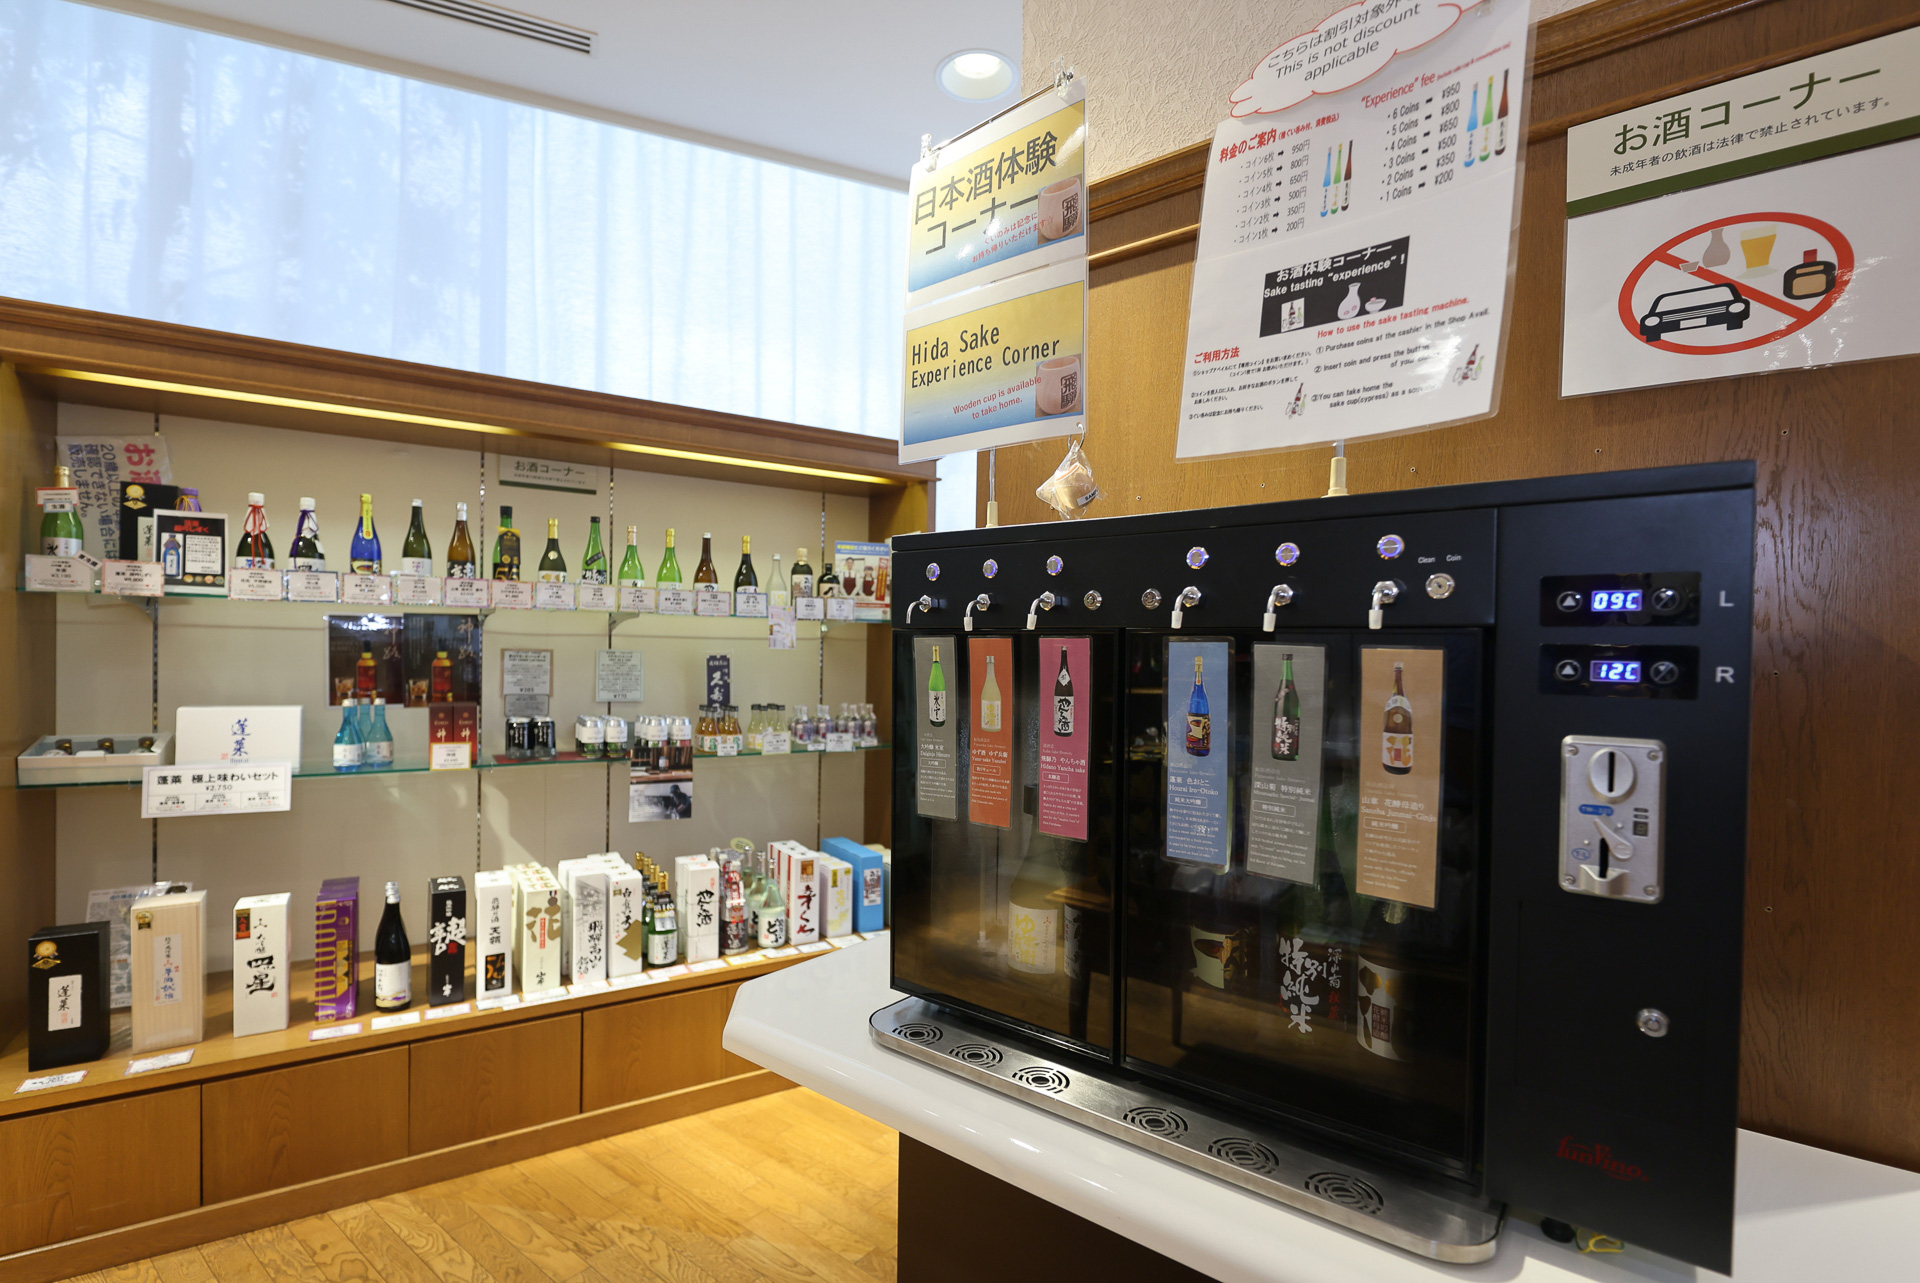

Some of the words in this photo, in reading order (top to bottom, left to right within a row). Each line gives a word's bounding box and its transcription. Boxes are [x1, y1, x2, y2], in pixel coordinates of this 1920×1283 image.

[1276, 59, 1303, 79] This
[1308, 52, 1319, 64] is
[1324, 37, 1349, 57] not
[1353, 3, 1421, 43] discount
[1304, 41, 1379, 81] applicable
[1421, 72, 1436, 88] fee
[1392, 109, 1398, 120] 6
[1400, 102, 1420, 117] Coins
[1442, 81, 1461, 99] ¥950
[1613, 68, 1881, 155] お酒コーナー
[1391, 126, 1397, 136] 5
[1399, 118, 1419, 133] Coins
[1441, 99, 1460, 116] ¥800
[1219, 128, 1277, 162] 料金のご案内
[1390, 141, 1395, 152] 4
[1397, 135, 1417, 150] Coins
[1440, 116, 1459, 133] ¥650
[1609, 95, 1891, 176] 未成年者の飲酒は法律で禁止されています。
[1292, 139, 1310, 155] 950円
[1388, 158, 1394, 169] 3
[1396, 151, 1415, 166] Coins
[1438, 134, 1457, 151] ¥500
[1290, 154, 1309, 170] 800円
[1387, 175, 1392, 186] 2
[1394, 168, 1414, 183] Coins
[1436, 151, 1455, 168] ¥350
[915, 131, 1059, 226] 日本酒体験
[1289, 170, 1308, 185] 650円
[1386, 190, 1390, 202] 1
[1392, 185, 1412, 200] Coins
[1434, 169, 1454, 186] ¥200
[1288, 185, 1307, 201] 500円
[1287, 202, 1306, 216] 350円
[925, 195, 1039, 256] コーナー
[984, 211, 1039, 245] ぐいのみは記念に
[1286, 217, 1305, 232] 200円
[1276, 244, 1393, 283] お酒体験コーナー
[1263, 285, 1287, 299] Sake
[1290, 276, 1324, 292] tasting
[1317, 329, 1334, 340] How
[1336, 326, 1345, 335] to
[1347, 323, 1361, 333] use
[1363, 318, 1376, 329] the
[1378, 315, 1397, 326] sake
[1400, 307, 1429, 322] tasting
[1325, 340, 1355, 353] Purchase
[1356, 336, 1374, 346] coins
[1376, 333, 1383, 343] at
[1384, 331, 1396, 341] the
[1398, 324, 1423, 337] cashier
[1425, 321, 1432, 331] in
[1434, 319, 1446, 329] the
[1448, 315, 1466, 327] Shop
[912, 337, 949, 366] Hida
[959, 324, 1000, 353] Sake
[1194, 346, 1240, 364] ご利用方法
[911, 354, 993, 389] Experience
[1002, 339, 1060, 367] Corner
[1323, 361, 1342, 372] Insert
[1344, 359, 1357, 368] coin
[1359, 355, 1371, 365] and
[1373, 352, 1391, 364] press
[1393, 349, 1405, 359] the
[1390, 359, 1399, 368] of
[952, 399, 982, 415] Wooden
[982, 394, 997, 406] cup
[998, 389, 1005, 398] is
[1007, 375, 1042, 396] available
[1329, 400, 1345, 409] sake
[1391, 390, 1399, 398] as
[1332, 390, 1345, 399] can
[1346, 386, 1361, 397] take
[1363, 384, 1380, 395] home
[1382, 381, 1394, 391] the
[972, 411, 980, 420] to
[981, 404, 998, 416] take
[999, 397, 1023, 410] home.
[514, 460, 585, 477] お酒コーナー
[1417, 556, 1436, 564] Clean
[1445, 554, 1462, 562] Coin
[1718, 590, 1735, 607] L
[1715, 666, 1736, 683] R
[157, 775, 182, 785] 蓬莱
[192, 772, 278, 785] 極上味わいセット
[205, 784, 233, 792] ¥2,750
[1169, 784, 1188, 793] Hourai
